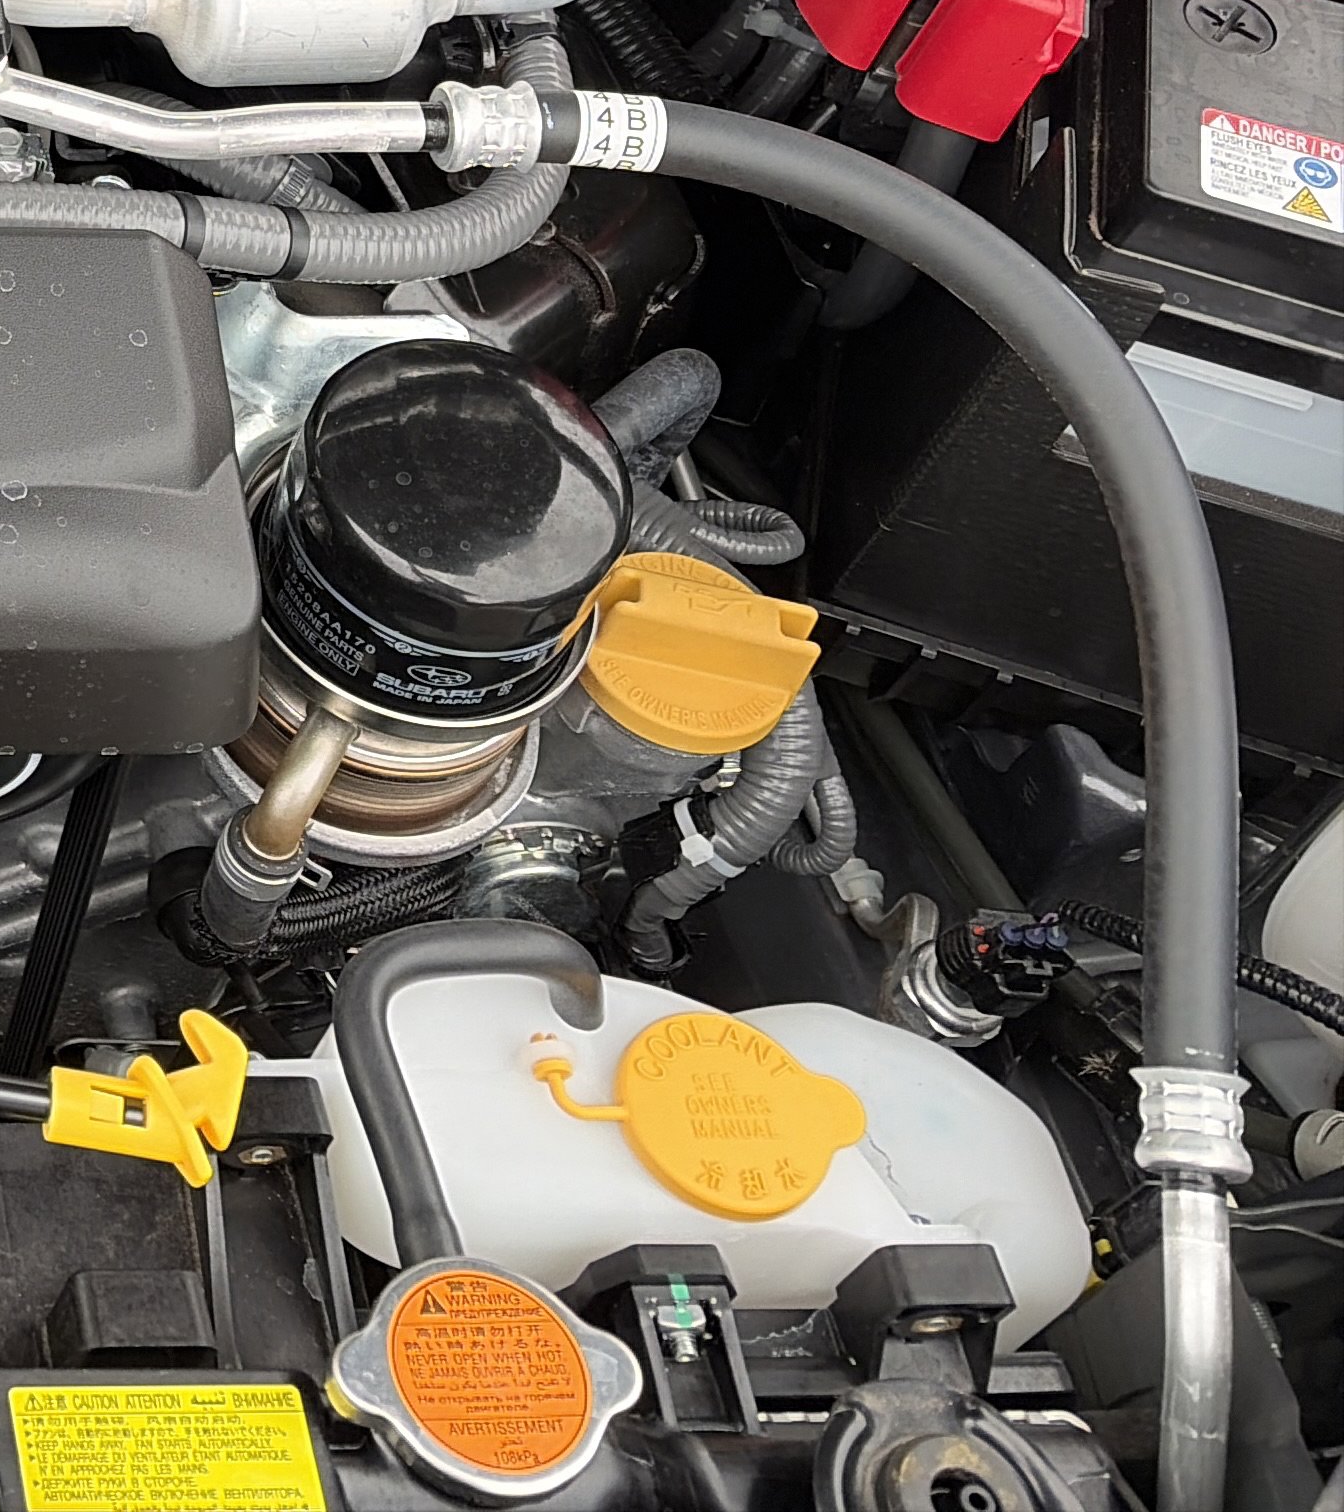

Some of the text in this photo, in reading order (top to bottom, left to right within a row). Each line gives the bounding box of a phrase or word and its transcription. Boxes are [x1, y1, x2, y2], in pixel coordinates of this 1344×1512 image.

[1210, 130, 1273, 155] FLUSH EYES
[1237, 118, 1309, 154] DANGER
[282, 579, 366, 661] GENUINE PARTS
[284, 562, 377, 657] 15208AA170
[317, 641, 359, 674] ONLY
[372, 680, 483, 706] MADE IN JAPAN
[375, 671, 489, 699] SUBARU
[633, 1019, 800, 1081] COOLANT
[691, 1072, 737, 1093] SEE
[684, 1094, 772, 1117] OWNERS
[689, 1118, 782, 1139] MANUAL
[445, 1293, 521, 1306] WARNING
[406, 1352, 448, 1367] NEVER
[453, 1352, 488, 1366] OPEN
[494, 1351, 532, 1365] WHEN
[409, 1367, 426, 1379] NE
[429, 1367, 470, 1379] JAMAIS
[72, 1392, 181, 1410] CAUTION ATTENTION
[448, 1419, 564, 1436] AVERTISSEMENT
[35, 1440, 59, 1451] KEEP
[62, 1440, 96, 1451] HANDS
[135, 1439, 153, 1451] FAN
[156, 1438, 193, 1450] STARTS
[37, 1452, 49, 1464] LE
[112, 1452, 127, 1464] DU
[494, 1451, 540, 1466] 108kPa
[70, 1464, 126, 1476] APPROCHEZ
[131, 1464, 150, 1476] PAS
[155, 1463, 172, 1475] LES
